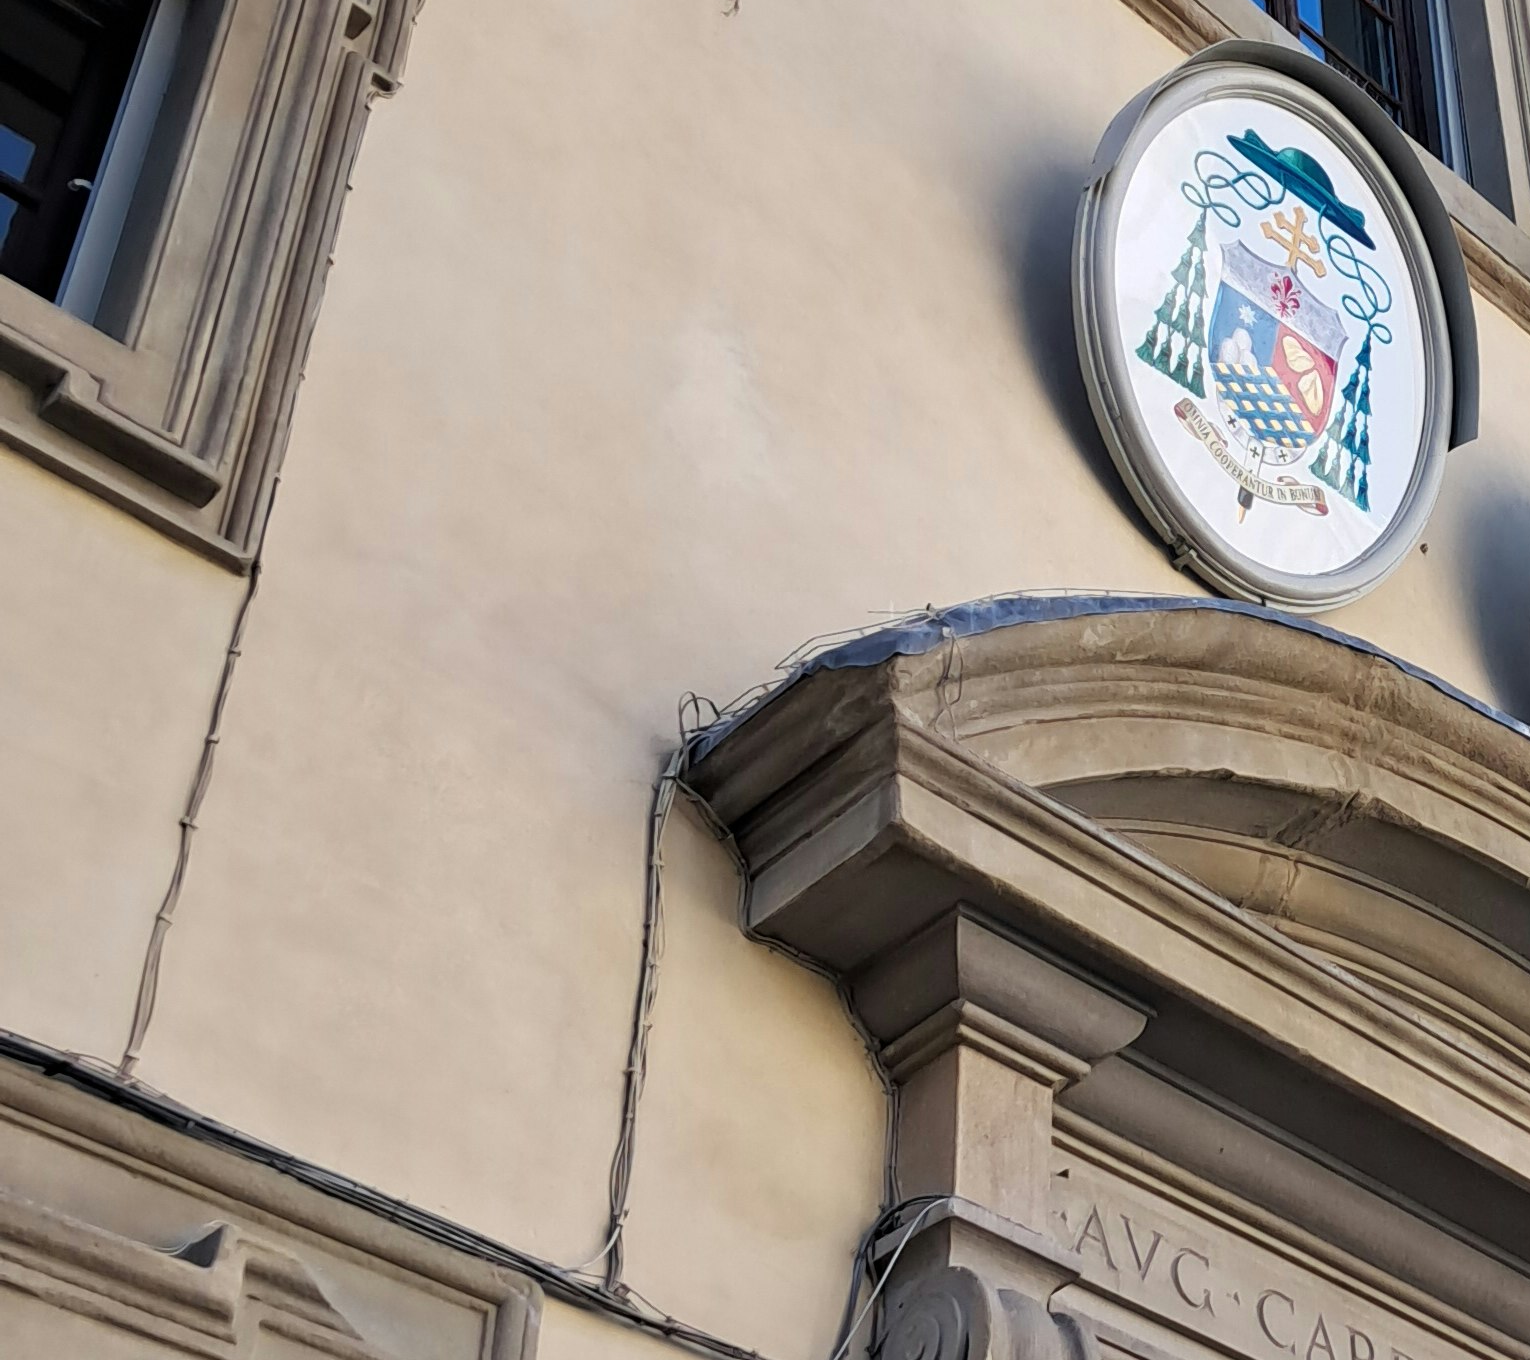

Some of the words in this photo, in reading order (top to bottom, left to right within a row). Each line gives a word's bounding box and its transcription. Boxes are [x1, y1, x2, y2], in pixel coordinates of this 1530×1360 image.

[1183, 402, 1211, 440] OMNIA
[1209, 440, 1274, 499] COOPERANTUR
[1276, 488, 1288, 501] IN
[1069, 1204, 1215, 1319] AVG
